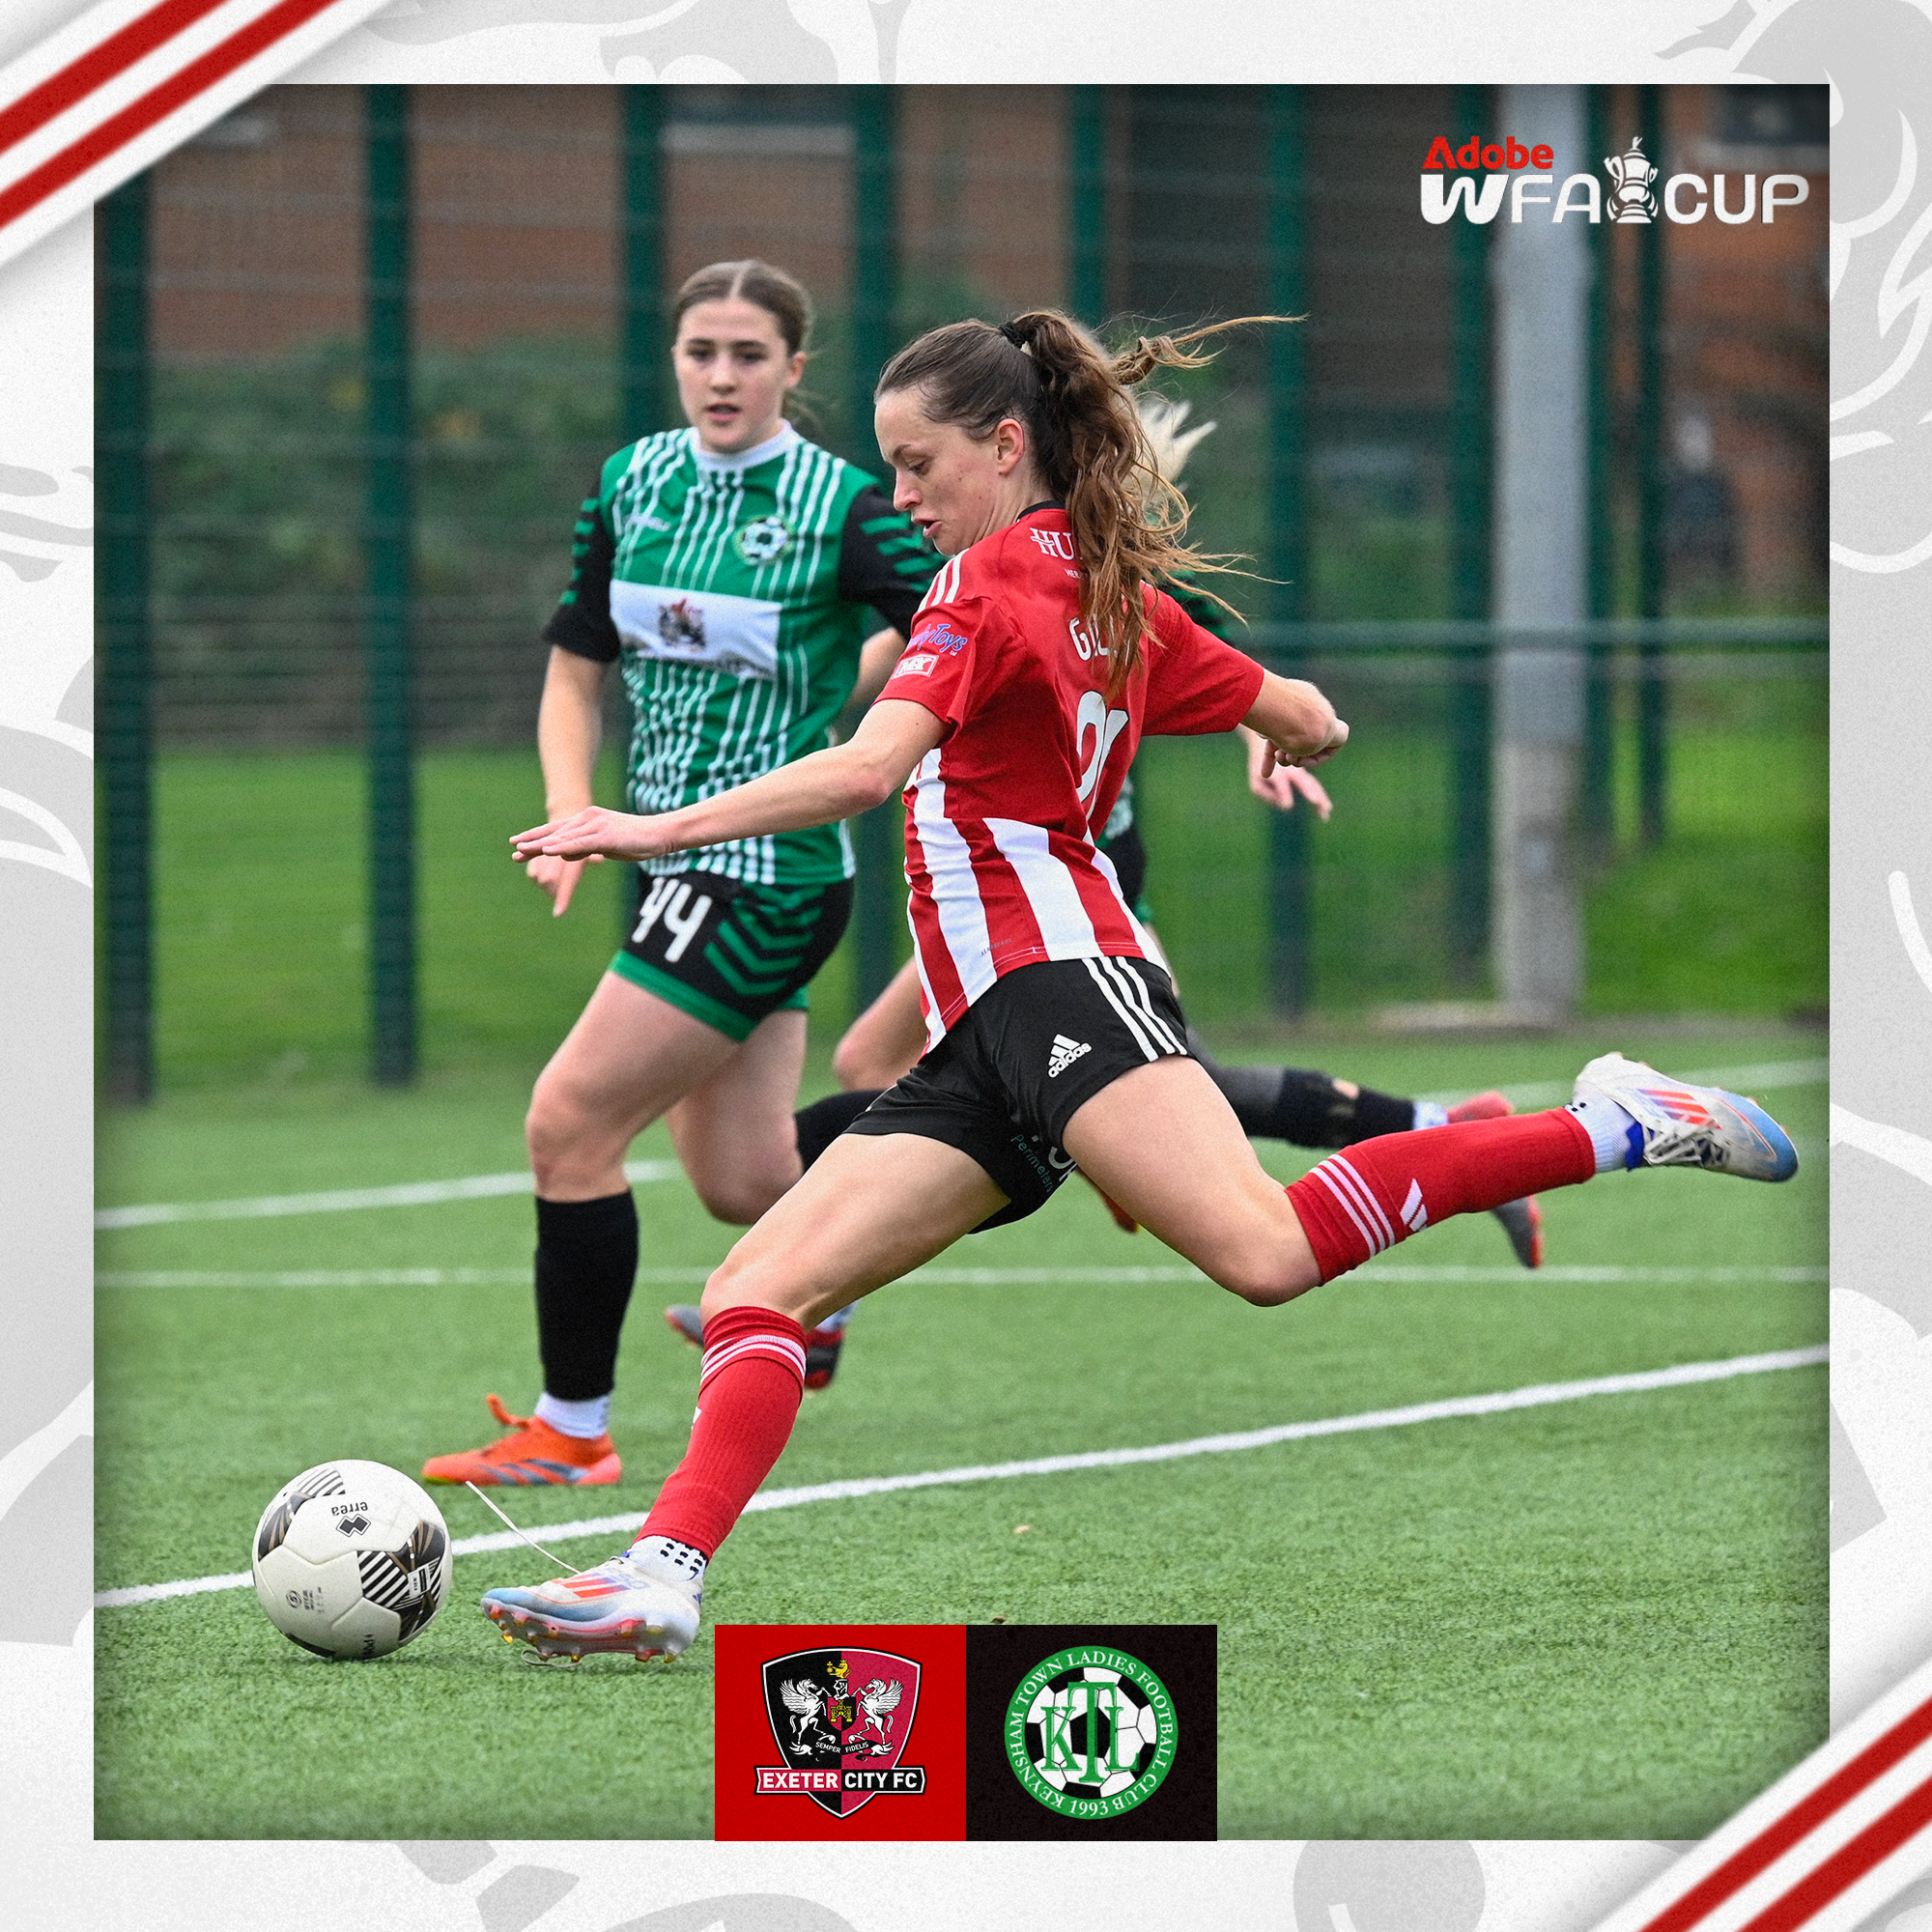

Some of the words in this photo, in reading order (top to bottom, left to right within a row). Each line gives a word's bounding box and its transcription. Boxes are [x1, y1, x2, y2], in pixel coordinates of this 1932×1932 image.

[1030, 527, 1075, 560] HU
[631, 876, 713, 963] 44
[1048, 1042, 1092, 1078] adidas
[331, 1501, 368, 1516] errea
